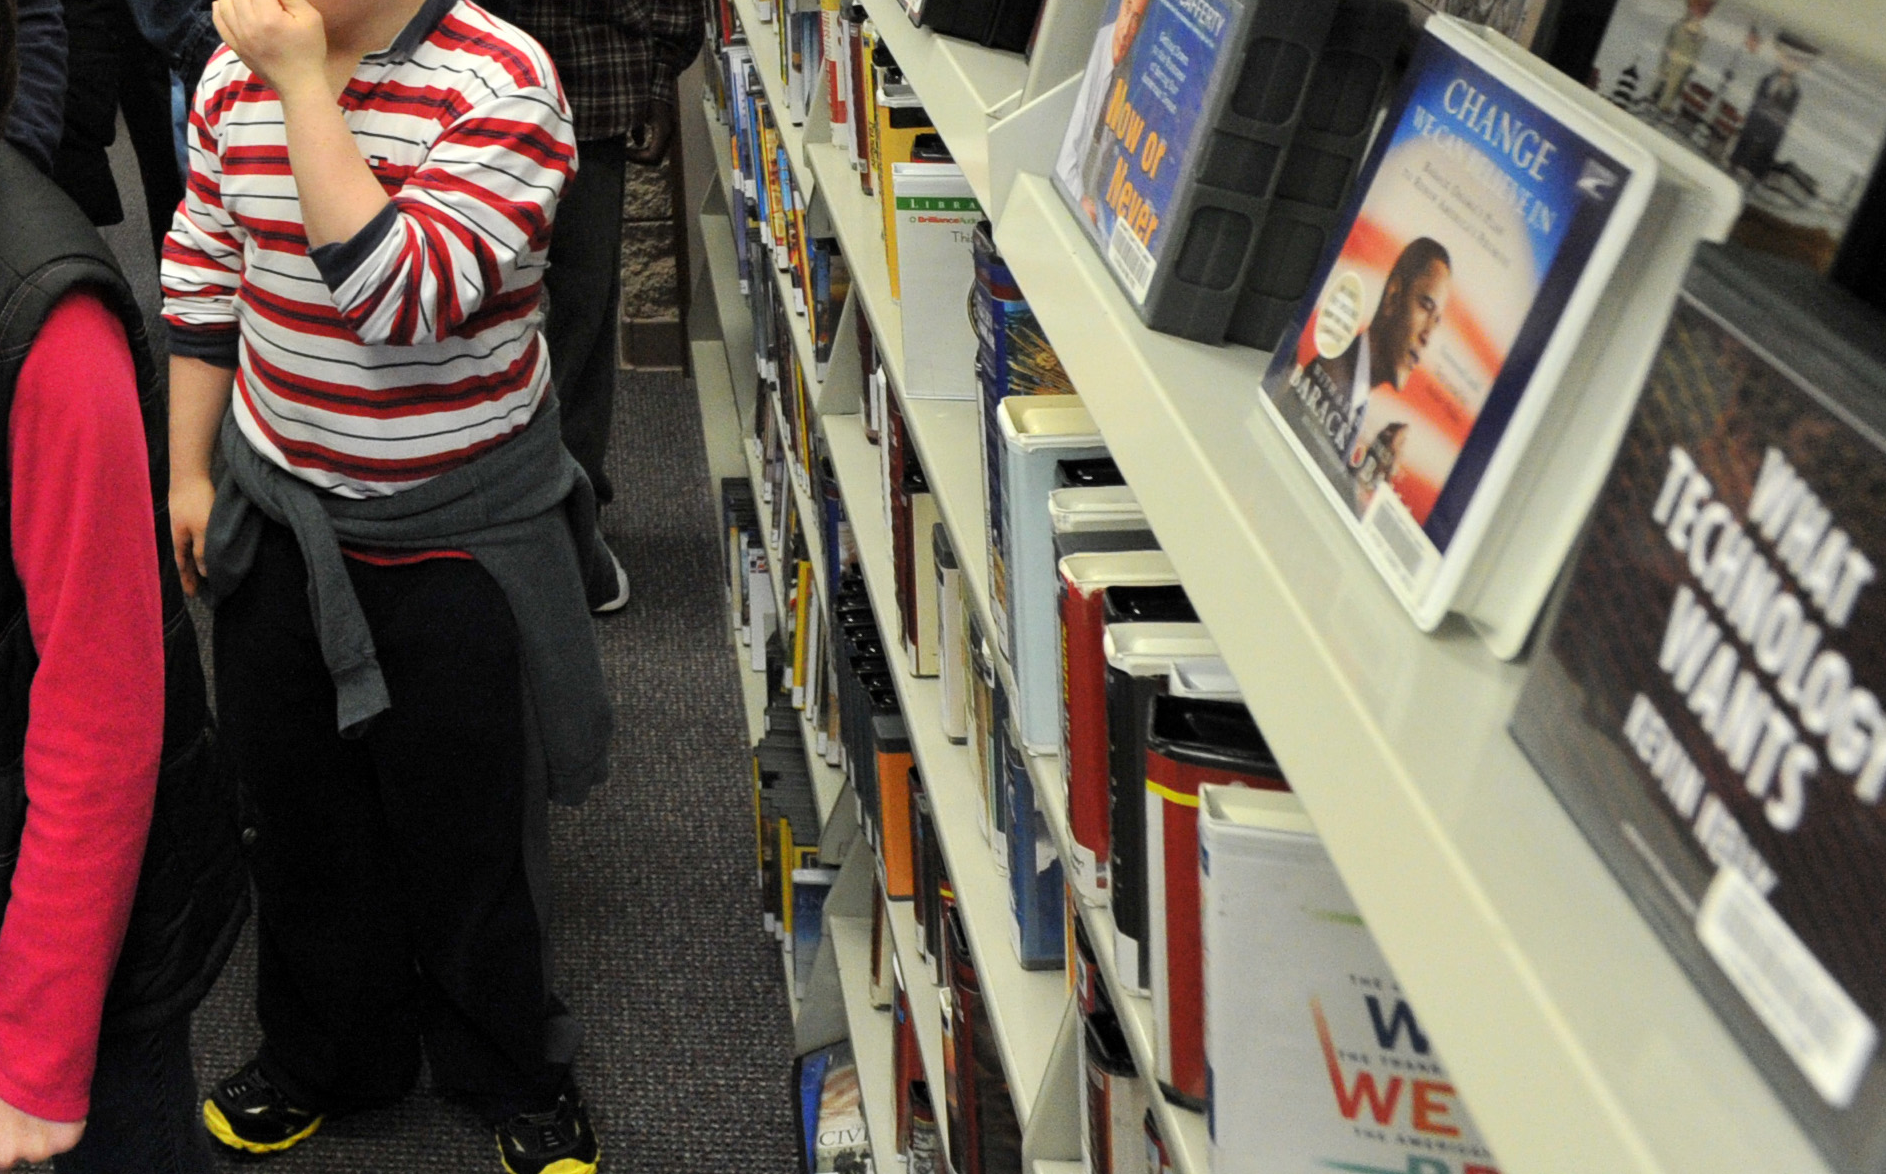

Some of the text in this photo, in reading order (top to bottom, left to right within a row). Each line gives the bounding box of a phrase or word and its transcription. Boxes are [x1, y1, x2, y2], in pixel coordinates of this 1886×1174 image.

[1105, 77, 1146, 155] Now
[1141, 130, 1168, 181] or
[1442, 77, 1559, 183] CHANGE
[1105, 154, 1160, 250] Never
[1747, 445, 1877, 630] WHAT
[1651, 444, 1886, 805] TECHNOLOGY
[1657, 582, 1819, 833] WANTS
[1309, 994, 1461, 1138] WE
